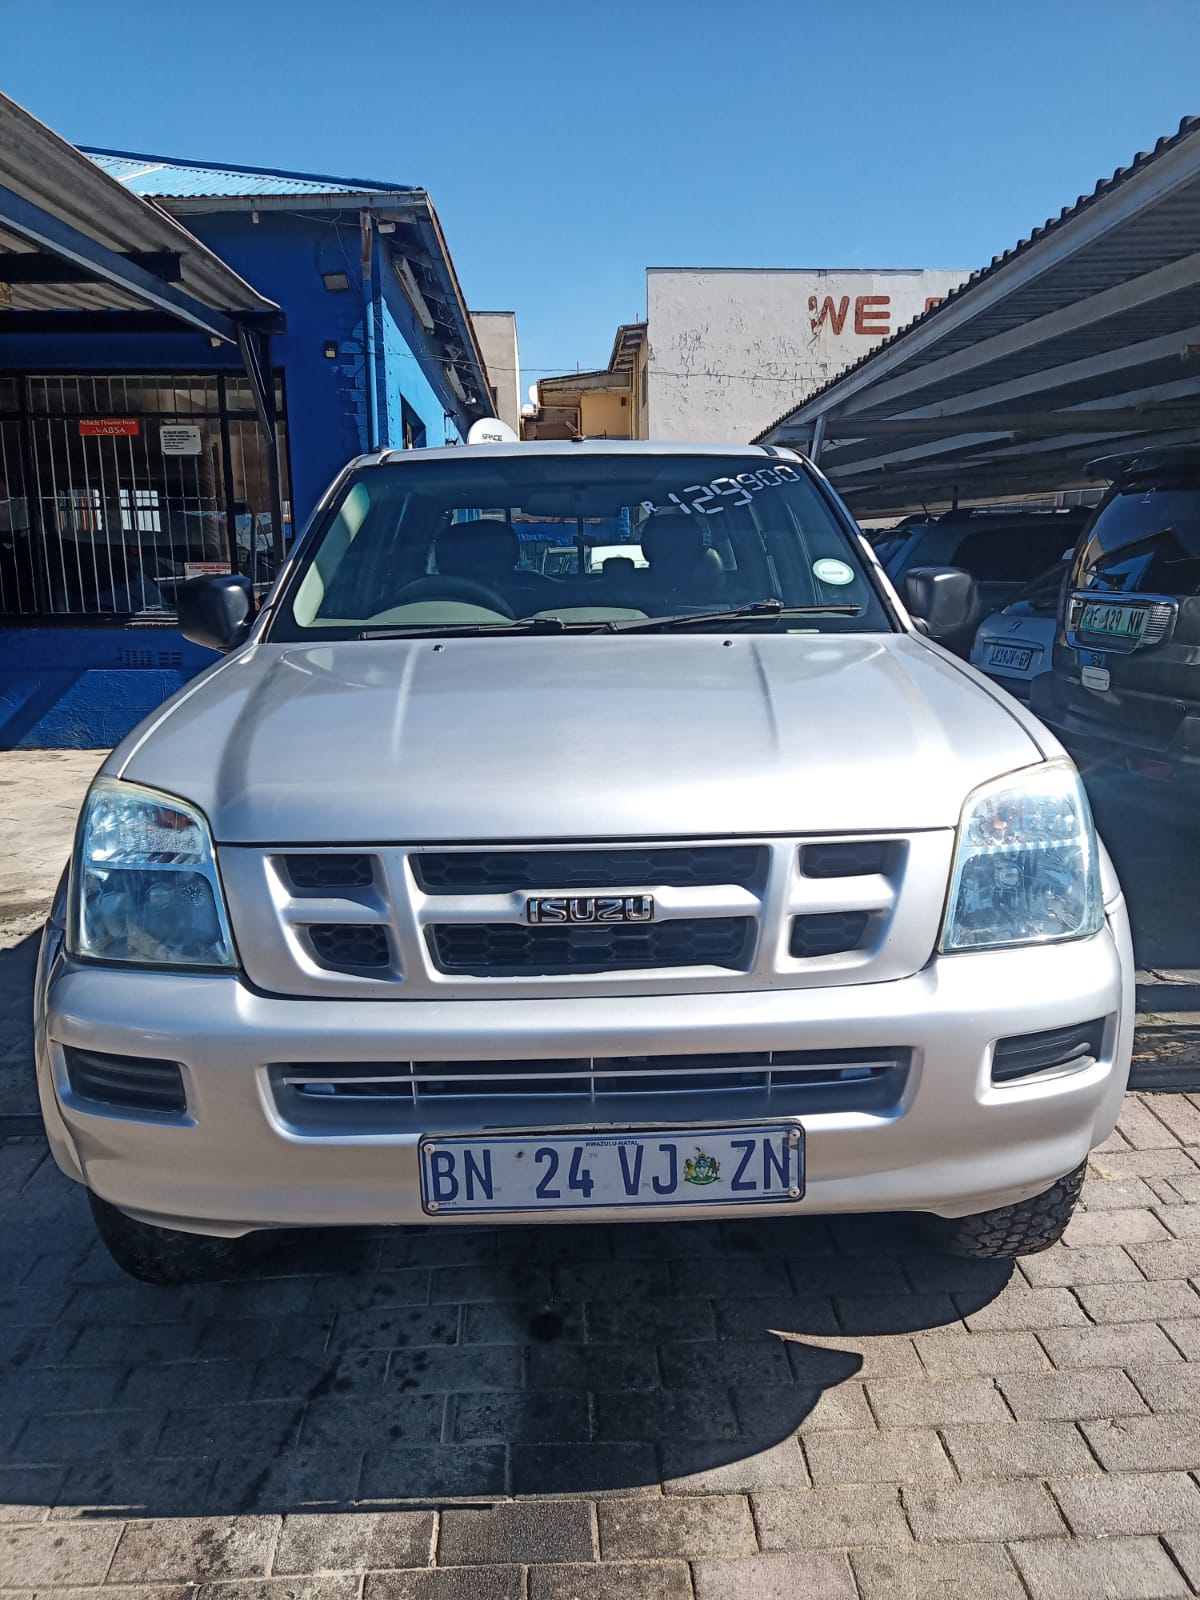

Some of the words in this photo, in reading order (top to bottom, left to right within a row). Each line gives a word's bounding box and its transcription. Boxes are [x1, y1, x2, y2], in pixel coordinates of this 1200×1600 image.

[808, 295, 891, 336] WE
[640, 500, 659, 514] R
[1103, 608, 1122, 631] 129
[529, 896, 651, 923] ISUZU
[430, 1148, 494, 1201] BN
[534, 1146, 595, 1199] 24
[617, 1143, 678, 1195] VJ
[730, 1138, 791, 1191] ZN
